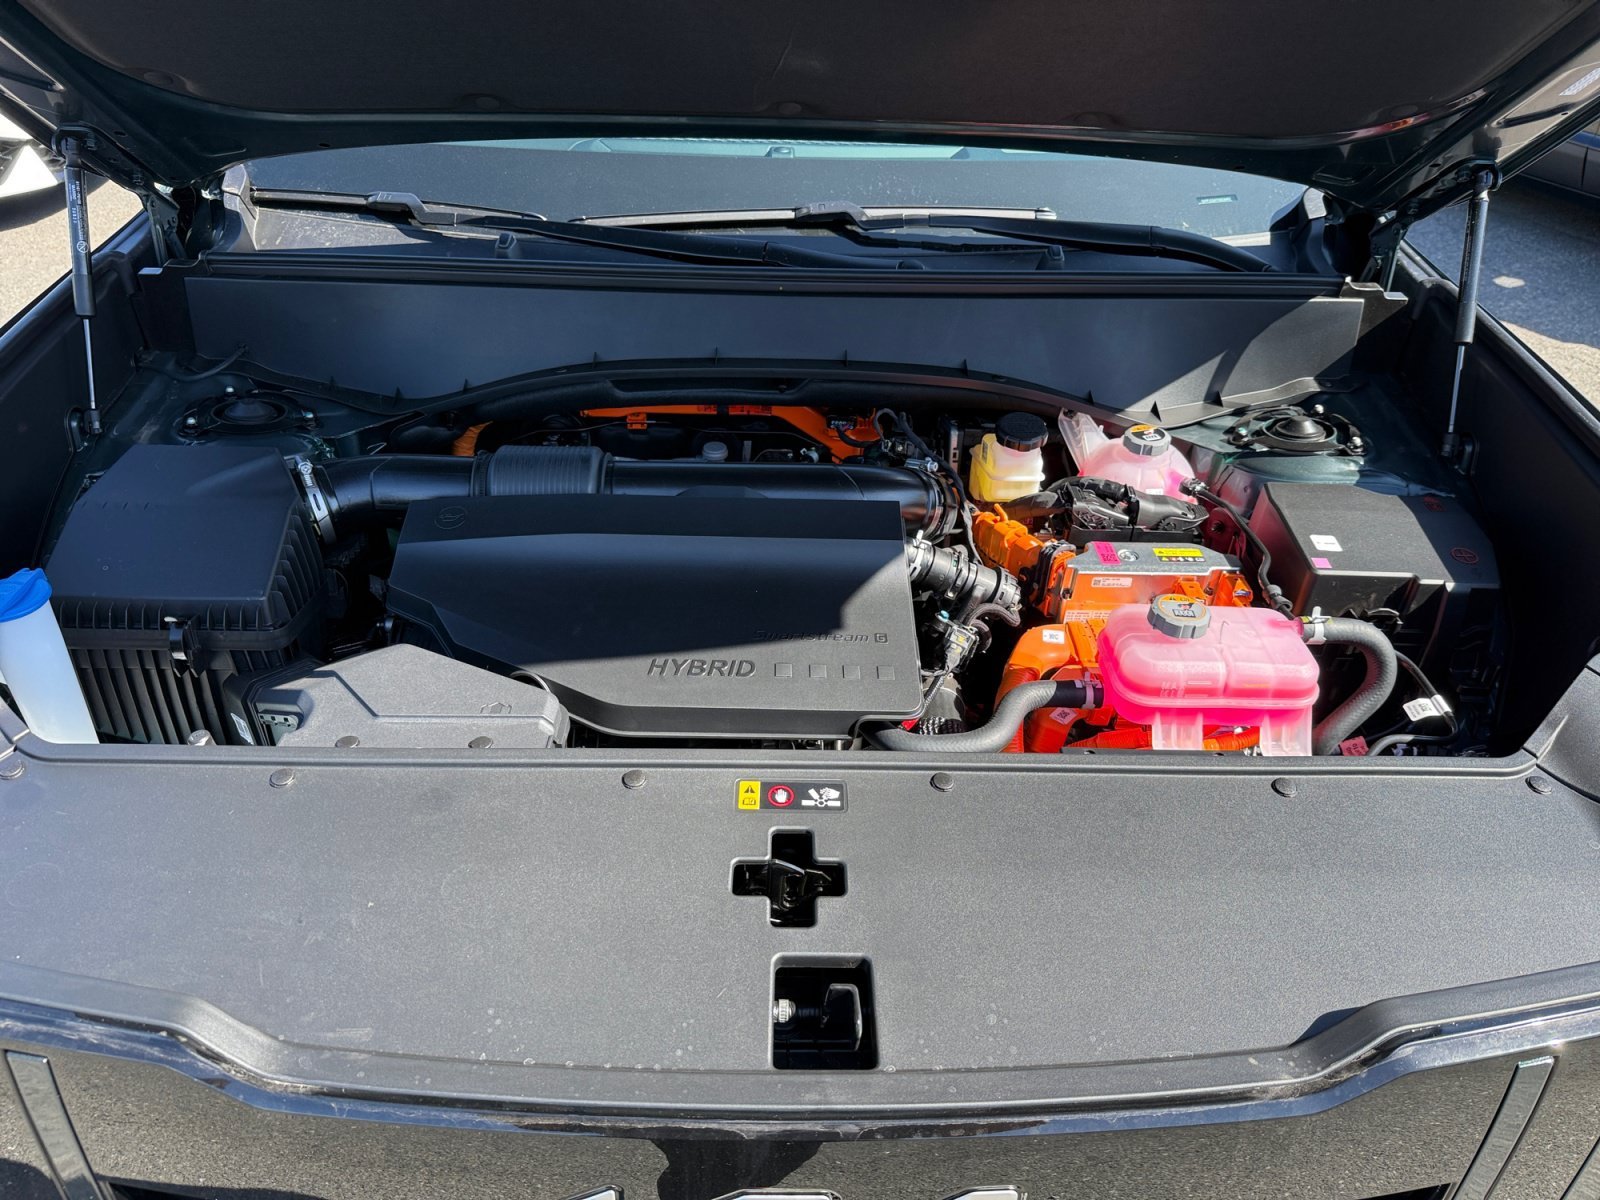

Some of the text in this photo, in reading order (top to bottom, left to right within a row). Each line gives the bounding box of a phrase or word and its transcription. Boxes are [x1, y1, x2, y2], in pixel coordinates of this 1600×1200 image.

[753, 630, 890, 646] Smartstream G
[647, 658, 756, 679] HYBRID
